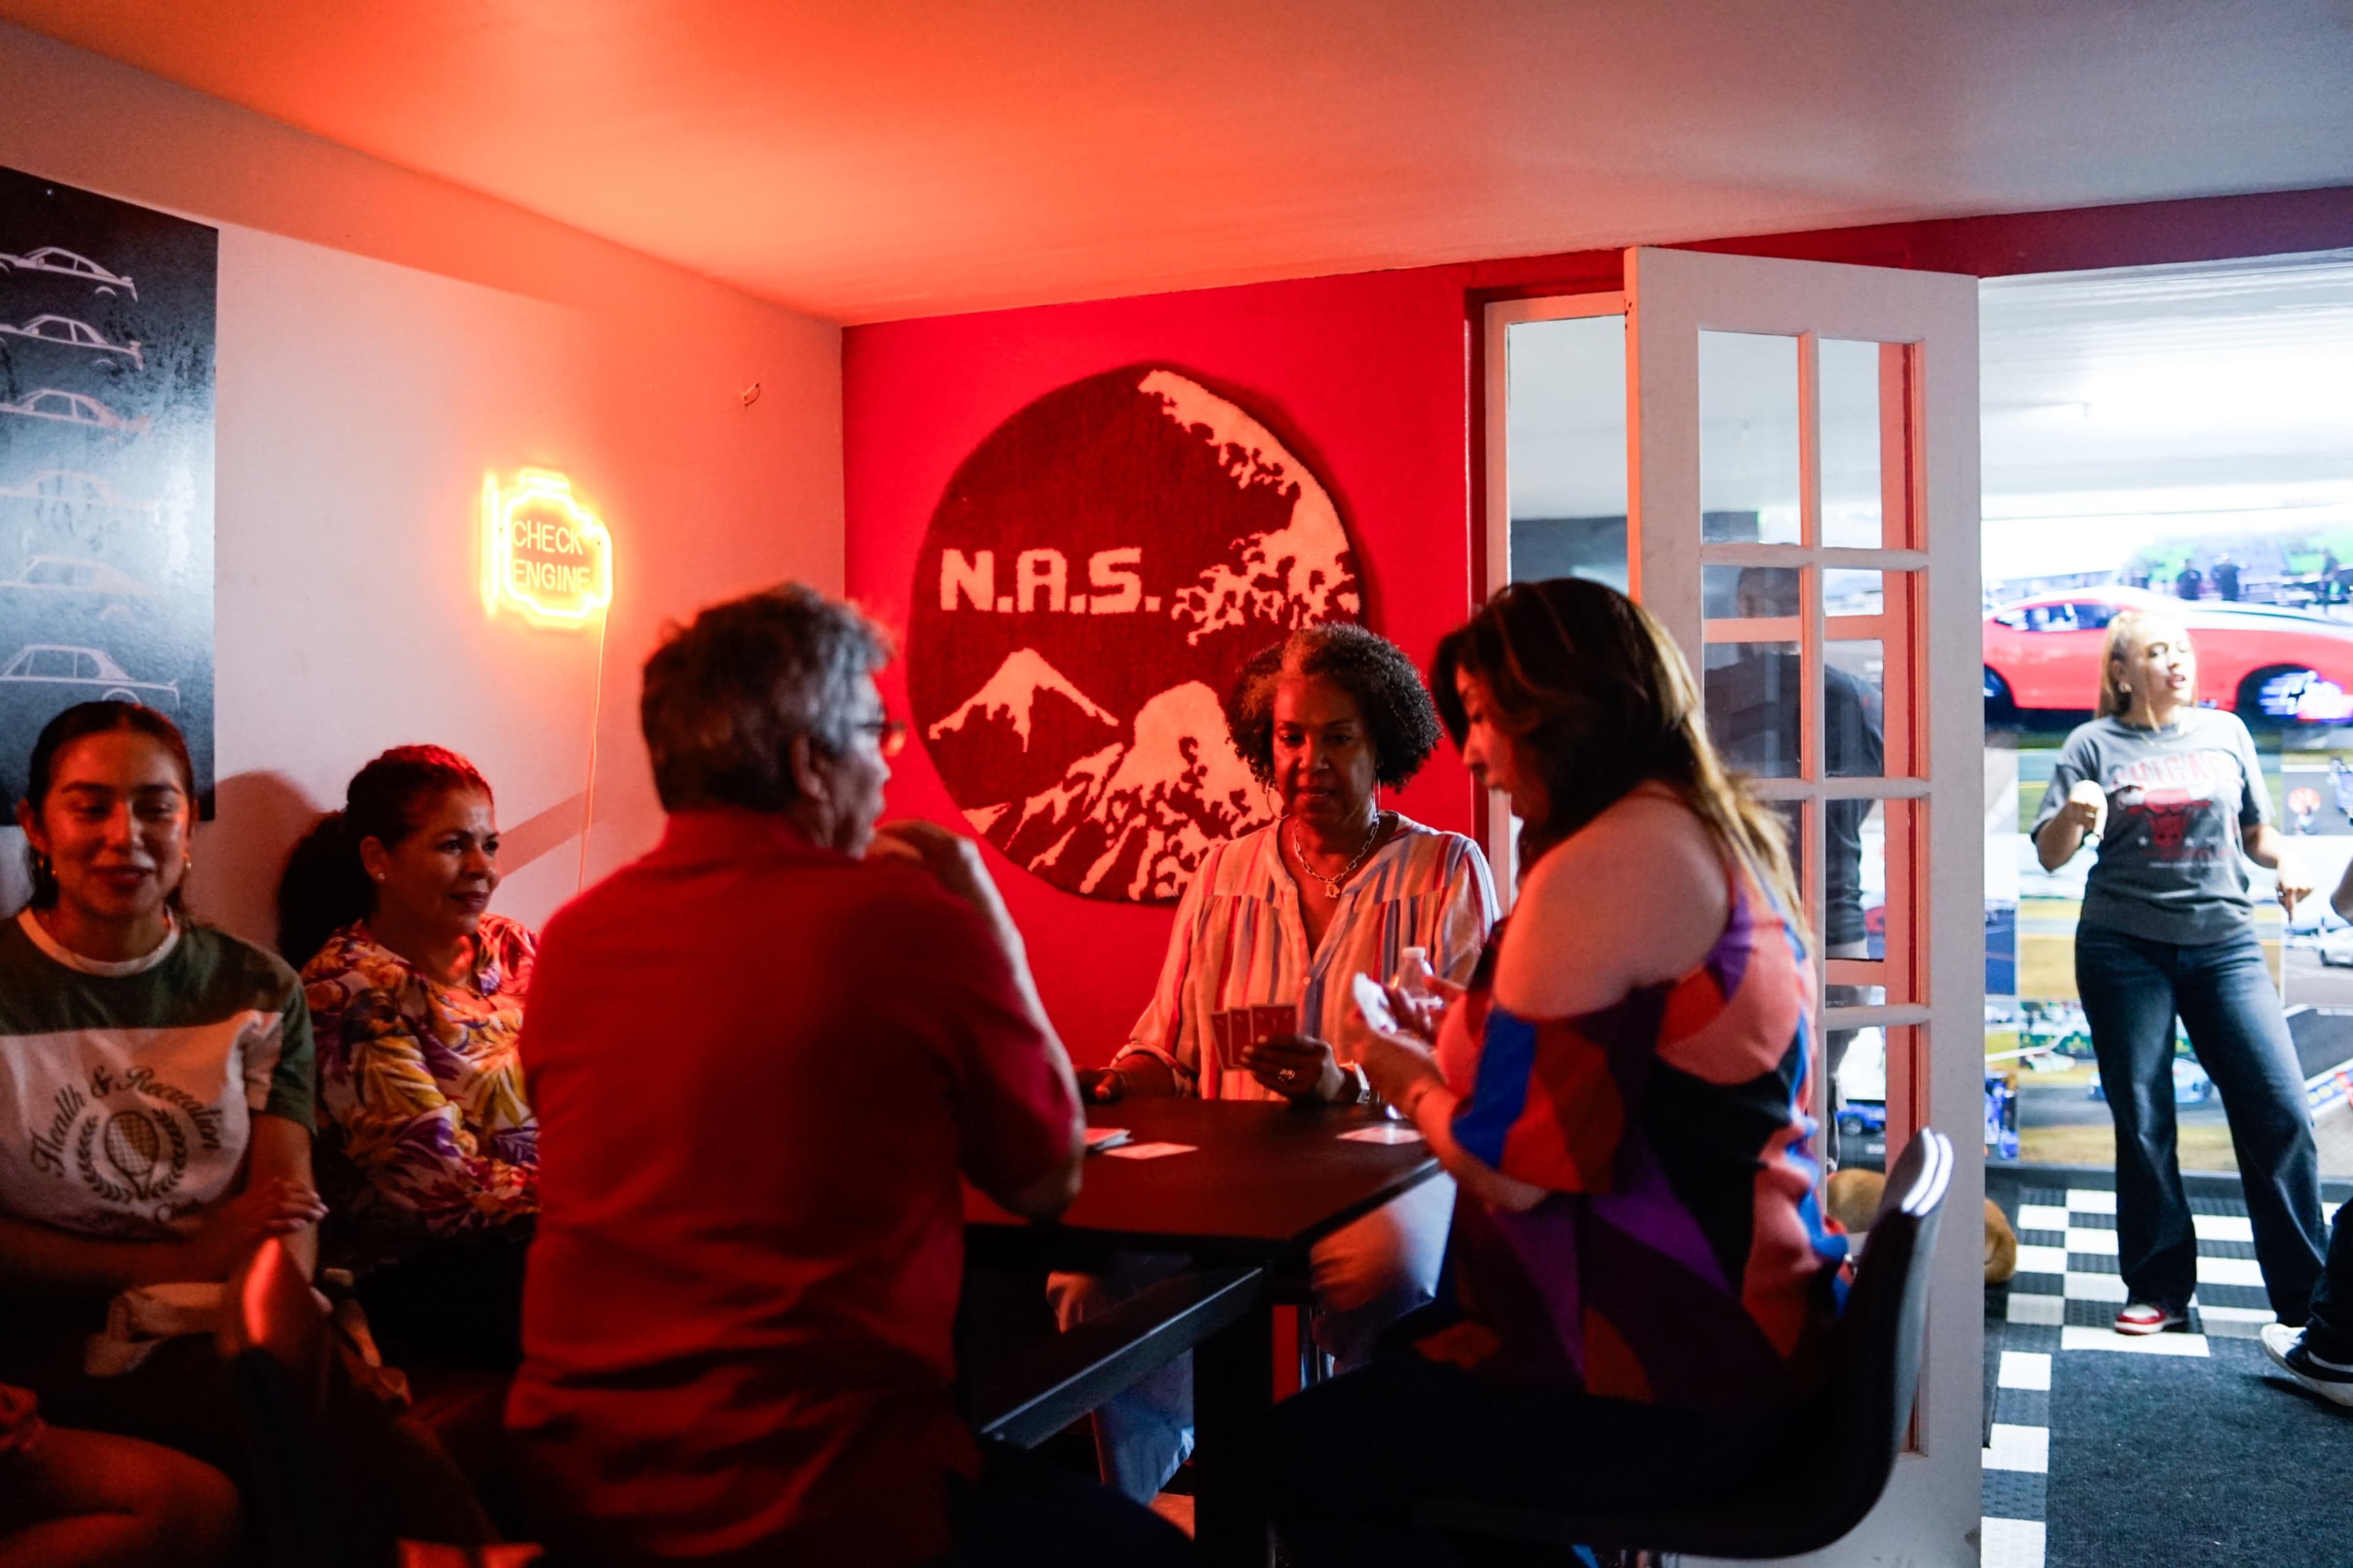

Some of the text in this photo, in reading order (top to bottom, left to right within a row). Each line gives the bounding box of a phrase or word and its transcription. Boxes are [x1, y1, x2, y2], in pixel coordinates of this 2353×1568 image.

[512, 520, 583, 555] CHECK
[513, 559, 591, 593] ENGINE
[940, 547, 1162, 615] N.A.S.
[2112, 752, 2240, 790] CHICA
[29, 1083, 86, 1177] Health
[91, 1065, 113, 1099] &
